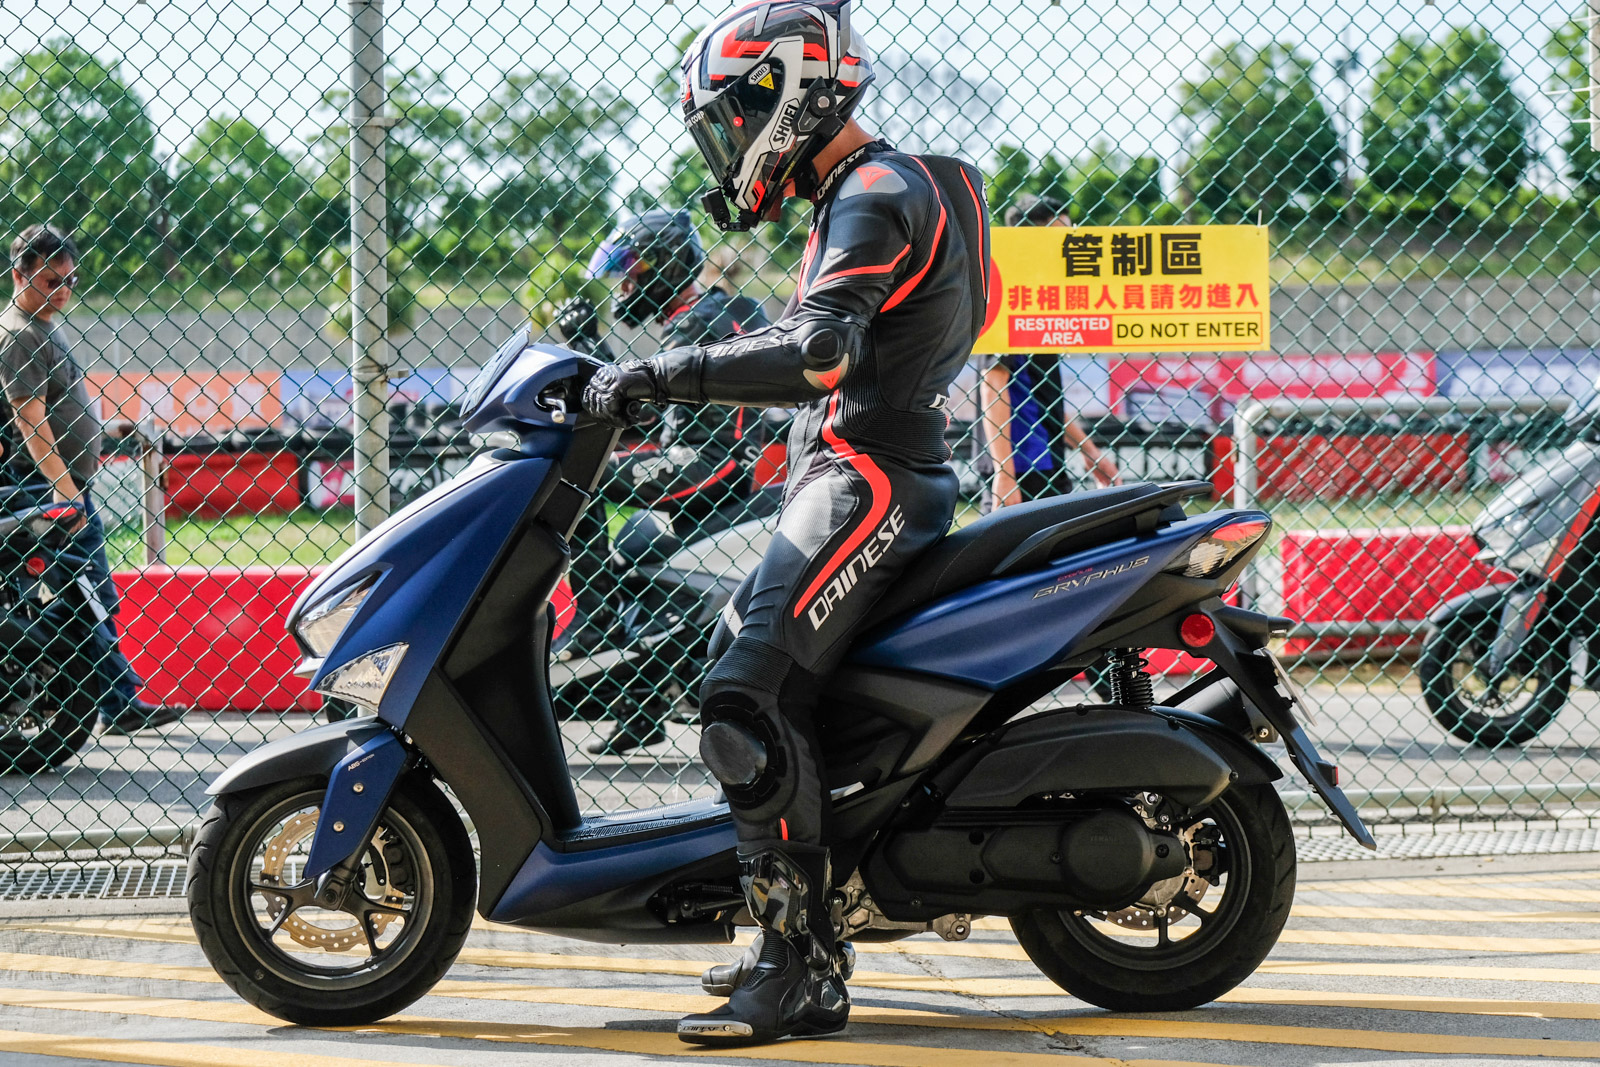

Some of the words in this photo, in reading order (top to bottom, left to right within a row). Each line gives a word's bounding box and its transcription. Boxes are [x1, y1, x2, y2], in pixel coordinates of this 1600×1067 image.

[751, 66, 768, 82] SHOEI
[772, 103, 799, 145] SHOEI
[1062, 233, 1202, 277] 管制區
[1008, 283, 1259, 311] 非相關人員請勿進入
[1015, 317, 1109, 331] RESTRICTED
[1117, 323, 1144, 338] DO
[1151, 323, 1189, 338] NOT
[1197, 322, 1259, 337] ENTER
[1041, 332, 1084, 345] AREA
[808, 504, 905, 631] DAINESE
[1032, 555, 1150, 600] GRYPHUS
